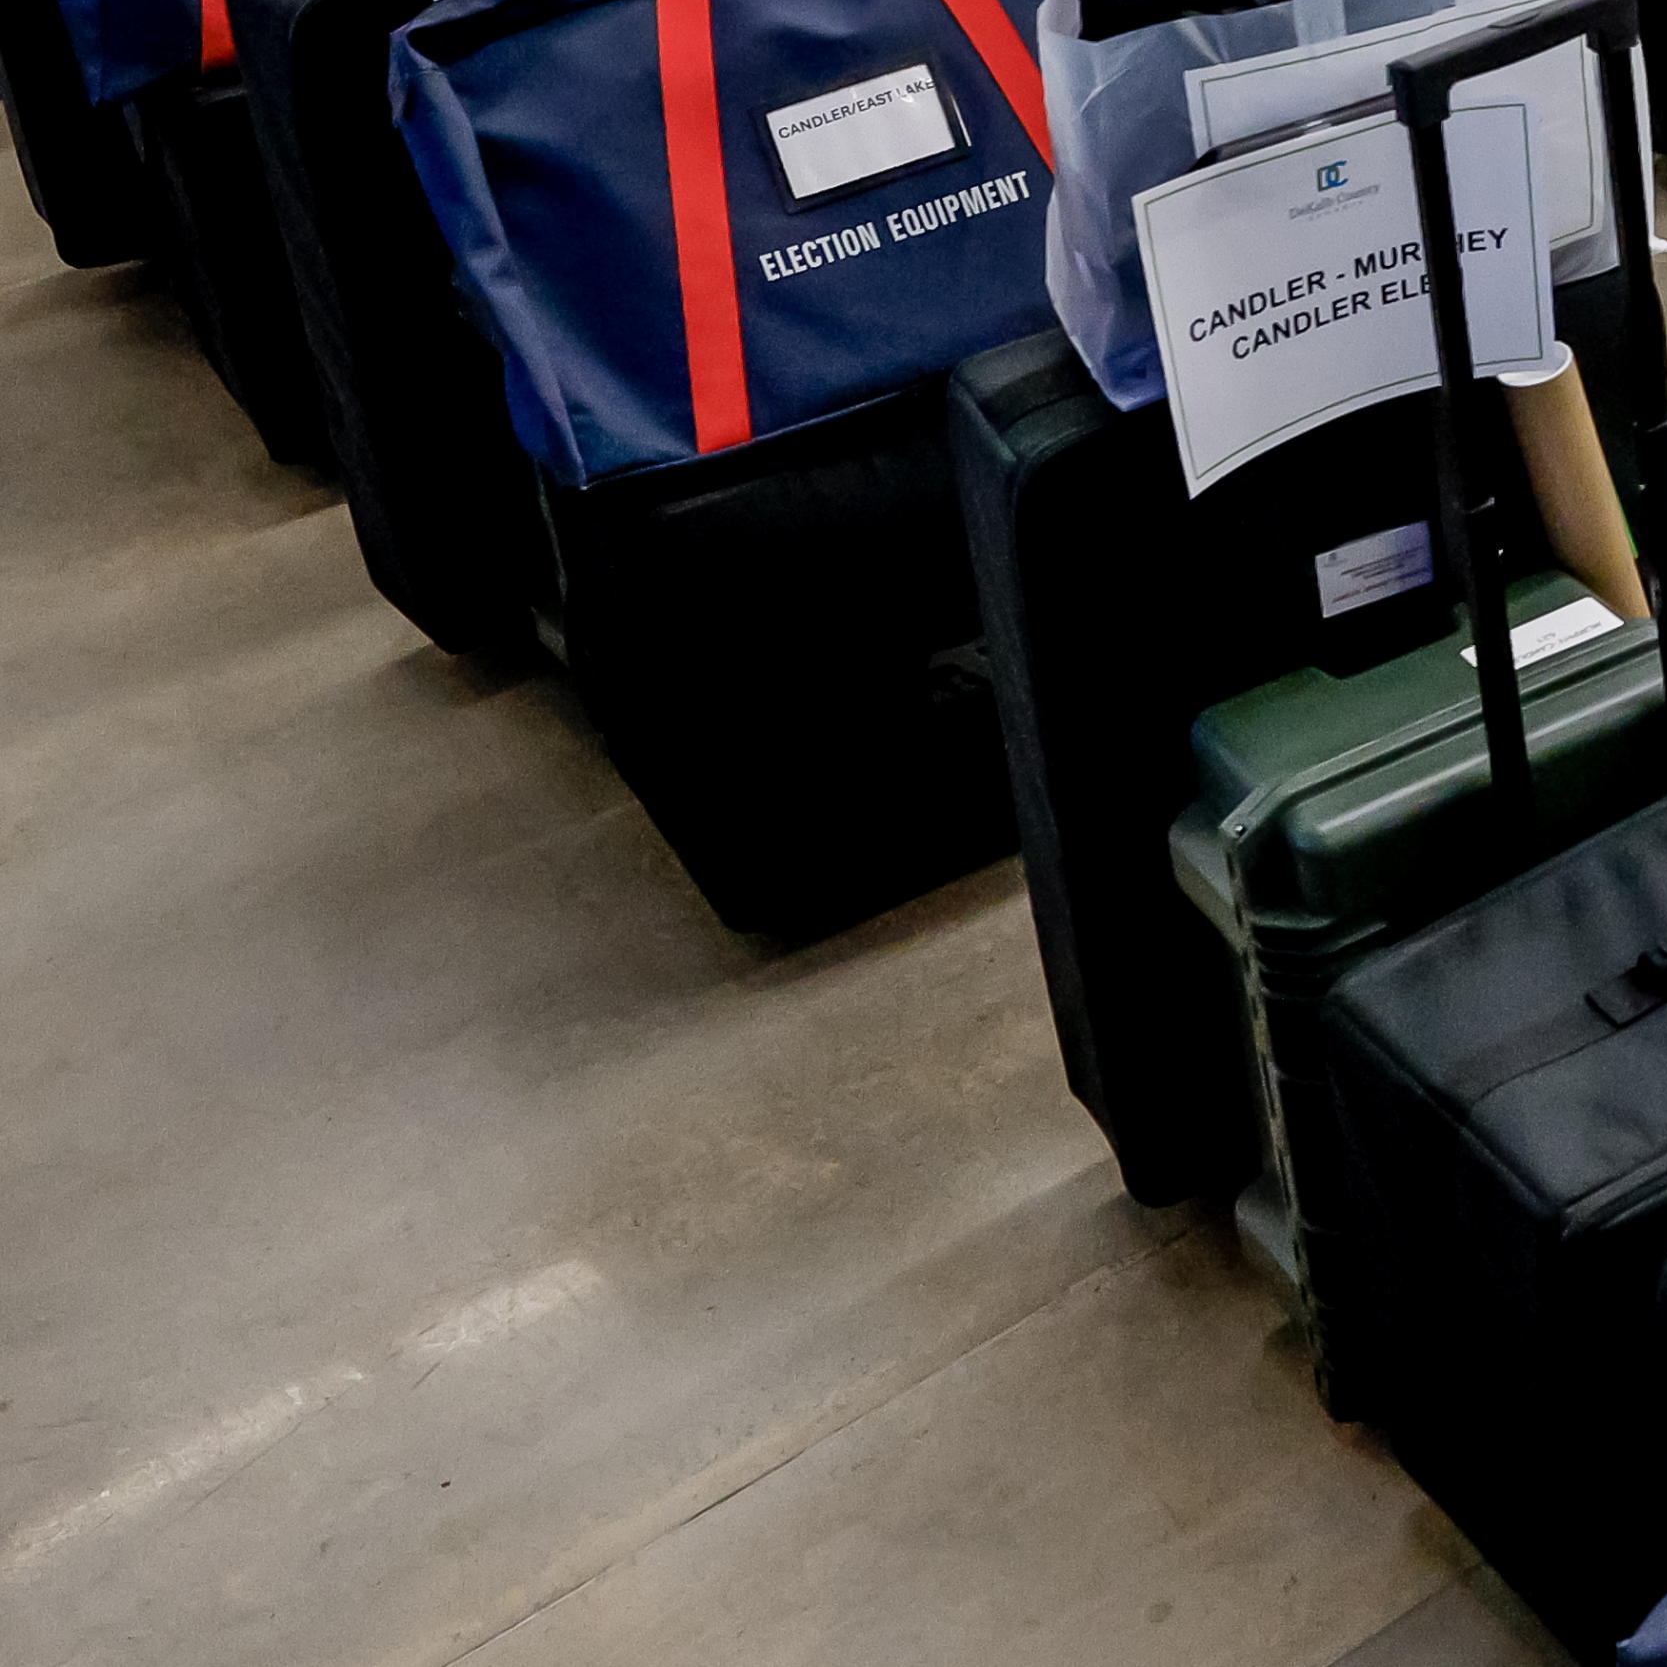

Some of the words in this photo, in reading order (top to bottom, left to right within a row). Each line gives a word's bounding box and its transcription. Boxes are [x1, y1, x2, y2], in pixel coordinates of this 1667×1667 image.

[778, 89, 893, 139] CANDLER/EAST
[896, 78, 936, 100] LAKE
[759, 222, 882, 281] ELECTION
[886, 171, 1031, 242] EQUIPMENT
[1189, 269, 1325, 344] CANDLER
[1231, 290, 1371, 360] CANDLER
[1381, 275, 1434, 305] ELE
